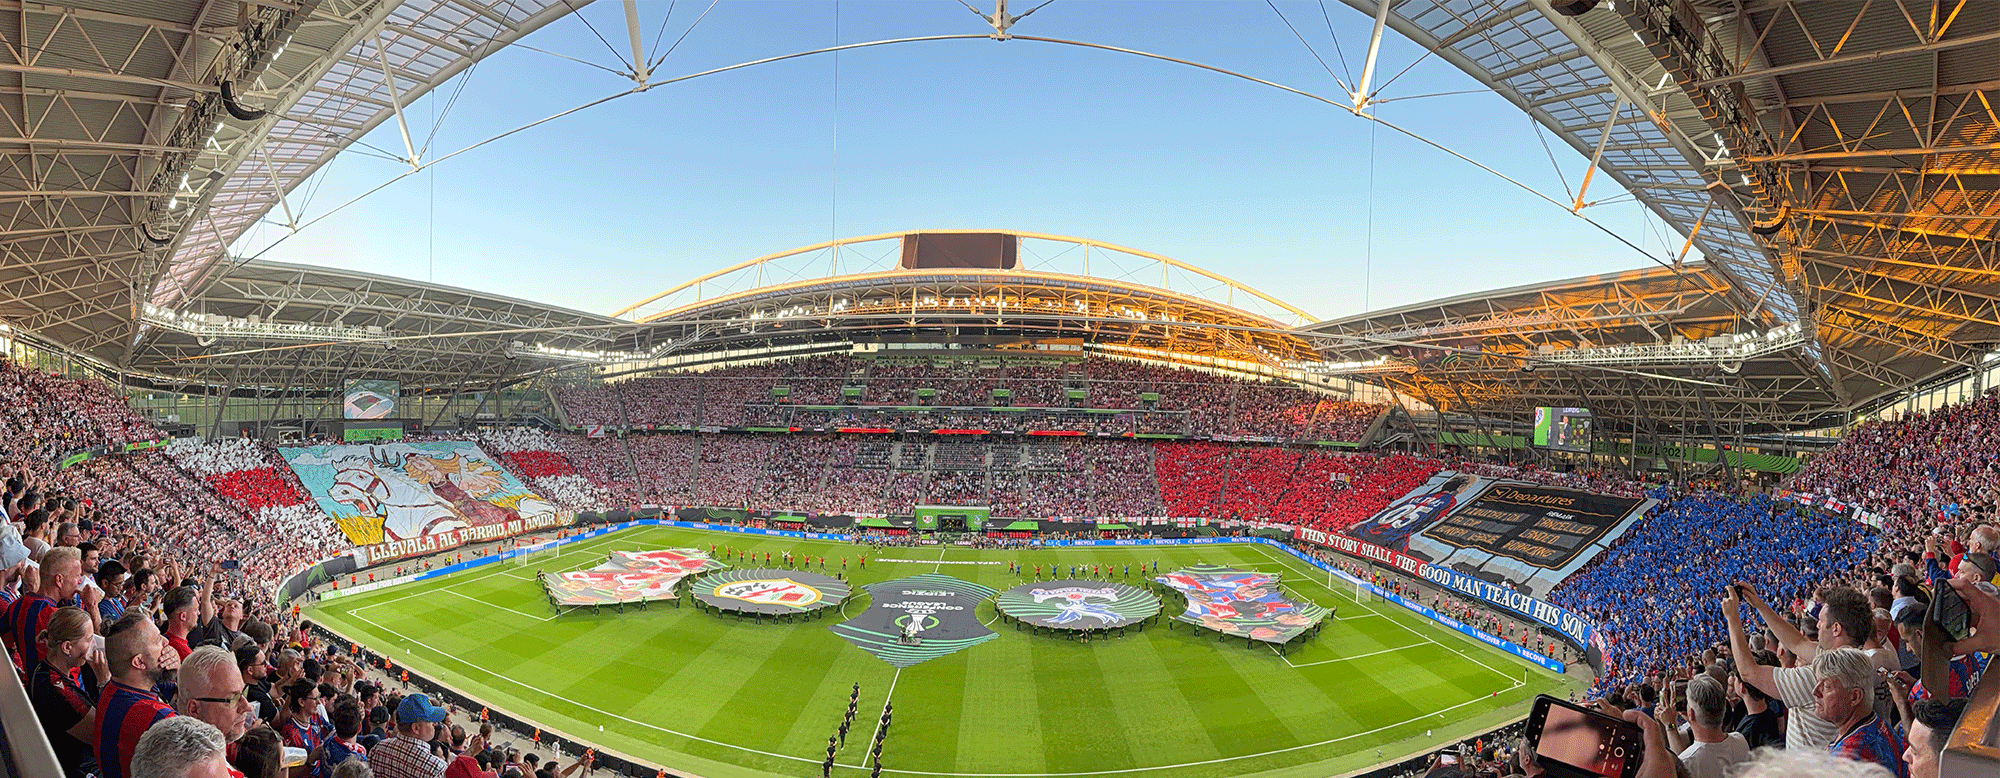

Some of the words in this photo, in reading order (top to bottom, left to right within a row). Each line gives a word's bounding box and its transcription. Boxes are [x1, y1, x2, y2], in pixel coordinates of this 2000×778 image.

[1505, 490, 1575, 506] Departures
[438, 532, 457, 548] AL
[524, 513, 556, 531] AMOR
[1300, 527, 1327, 544] THIS
[1327, 534, 1361, 556] STORY
[1360, 543, 1393, 564] SHALL
[1395, 554, 1418, 574] THE
[1418, 563, 1451, 585] GOOD
[1451, 575, 1484, 598] MAN
[1485, 583, 1533, 615] TEACH
[1532, 601, 1561, 626] HIS
[1477, 630, 1500, 646] RECOVER
[1522, 649, 1546, 665] RECOVE
